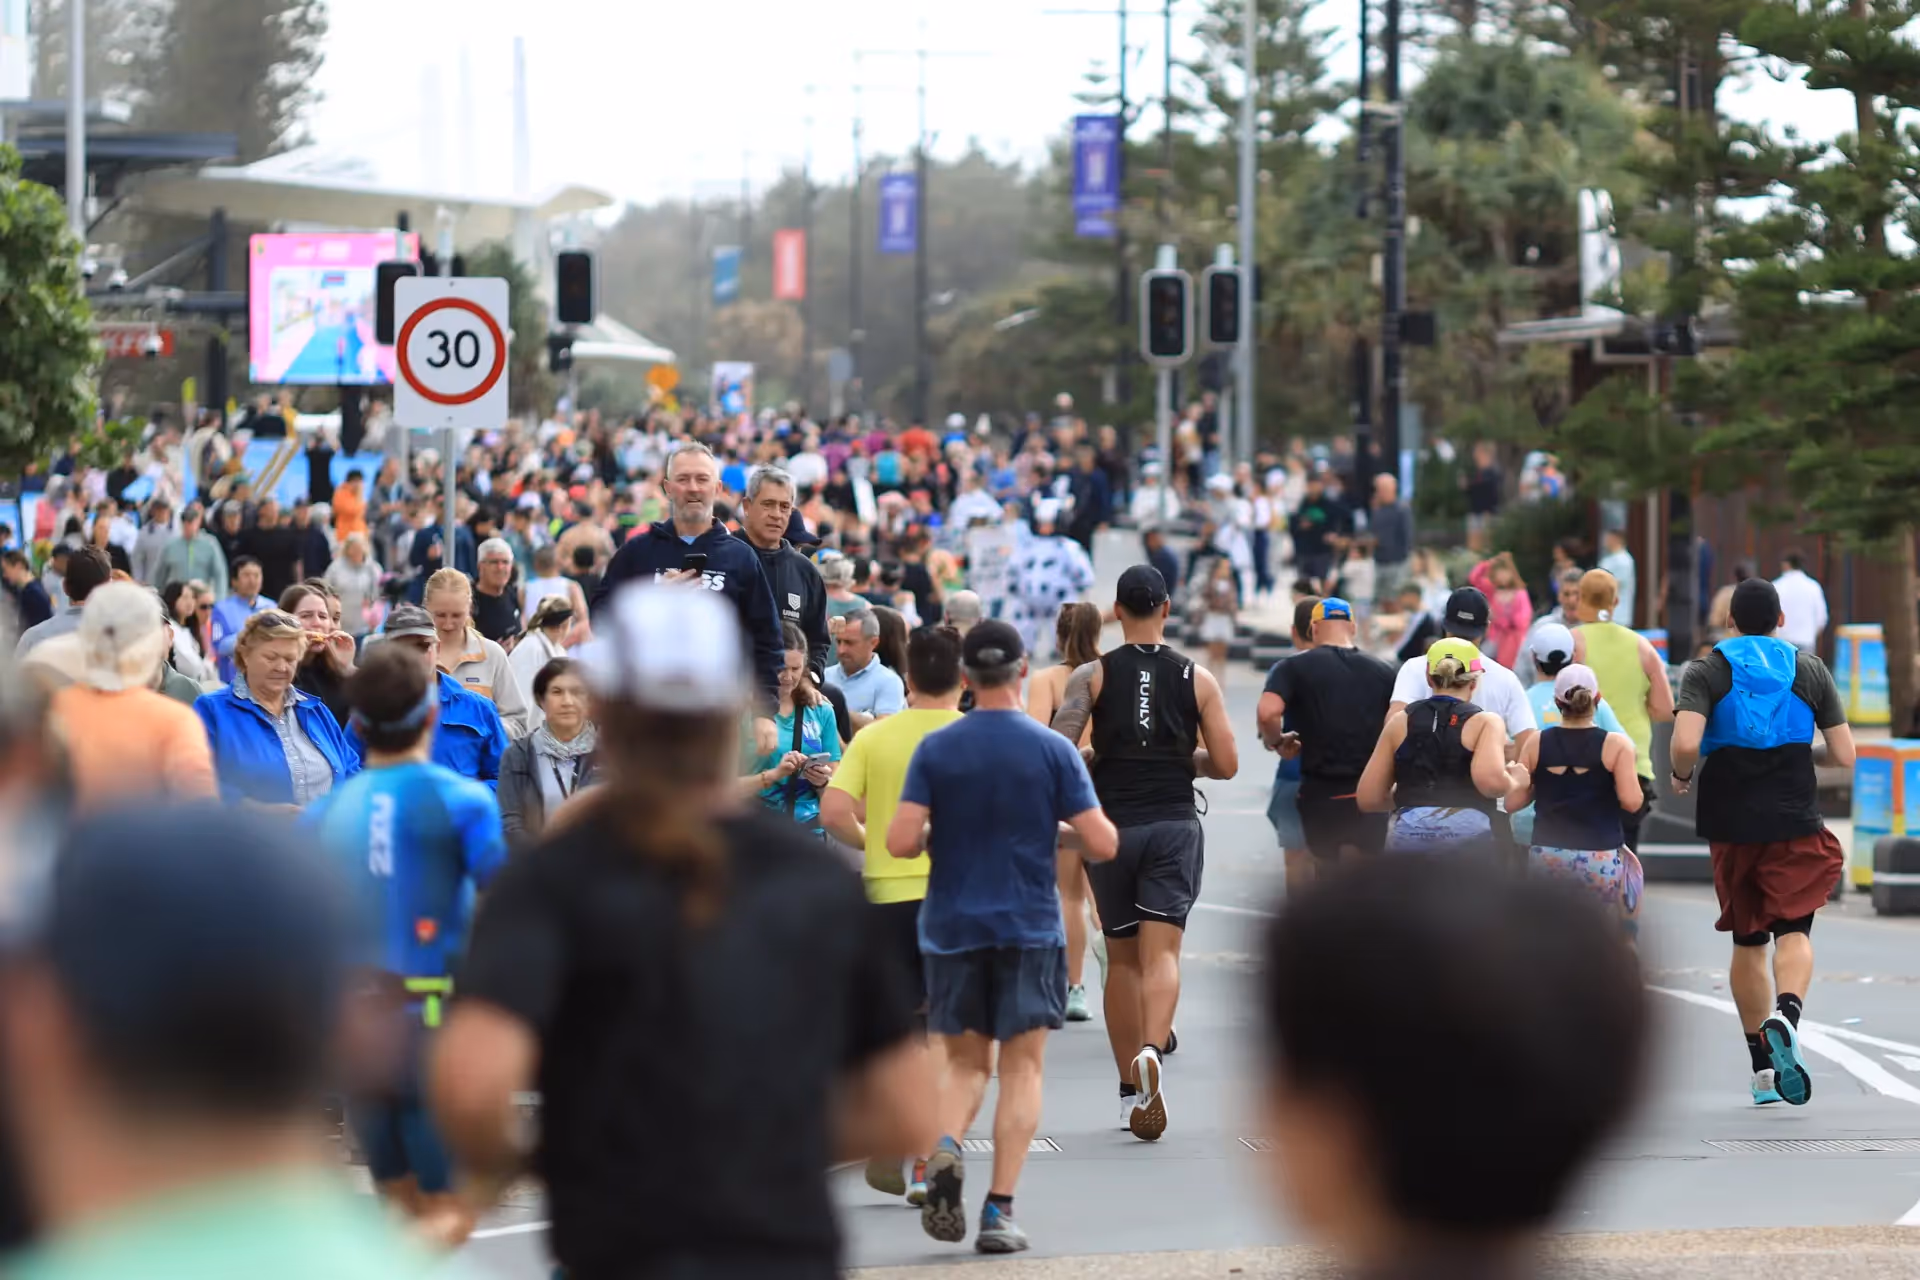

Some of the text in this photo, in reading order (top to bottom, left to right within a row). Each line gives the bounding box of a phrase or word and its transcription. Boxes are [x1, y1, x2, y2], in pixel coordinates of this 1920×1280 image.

[426, 329, 480, 369] 30
[1139, 670, 1151, 730] RUNLY
[368, 793, 395, 875] 2XU
